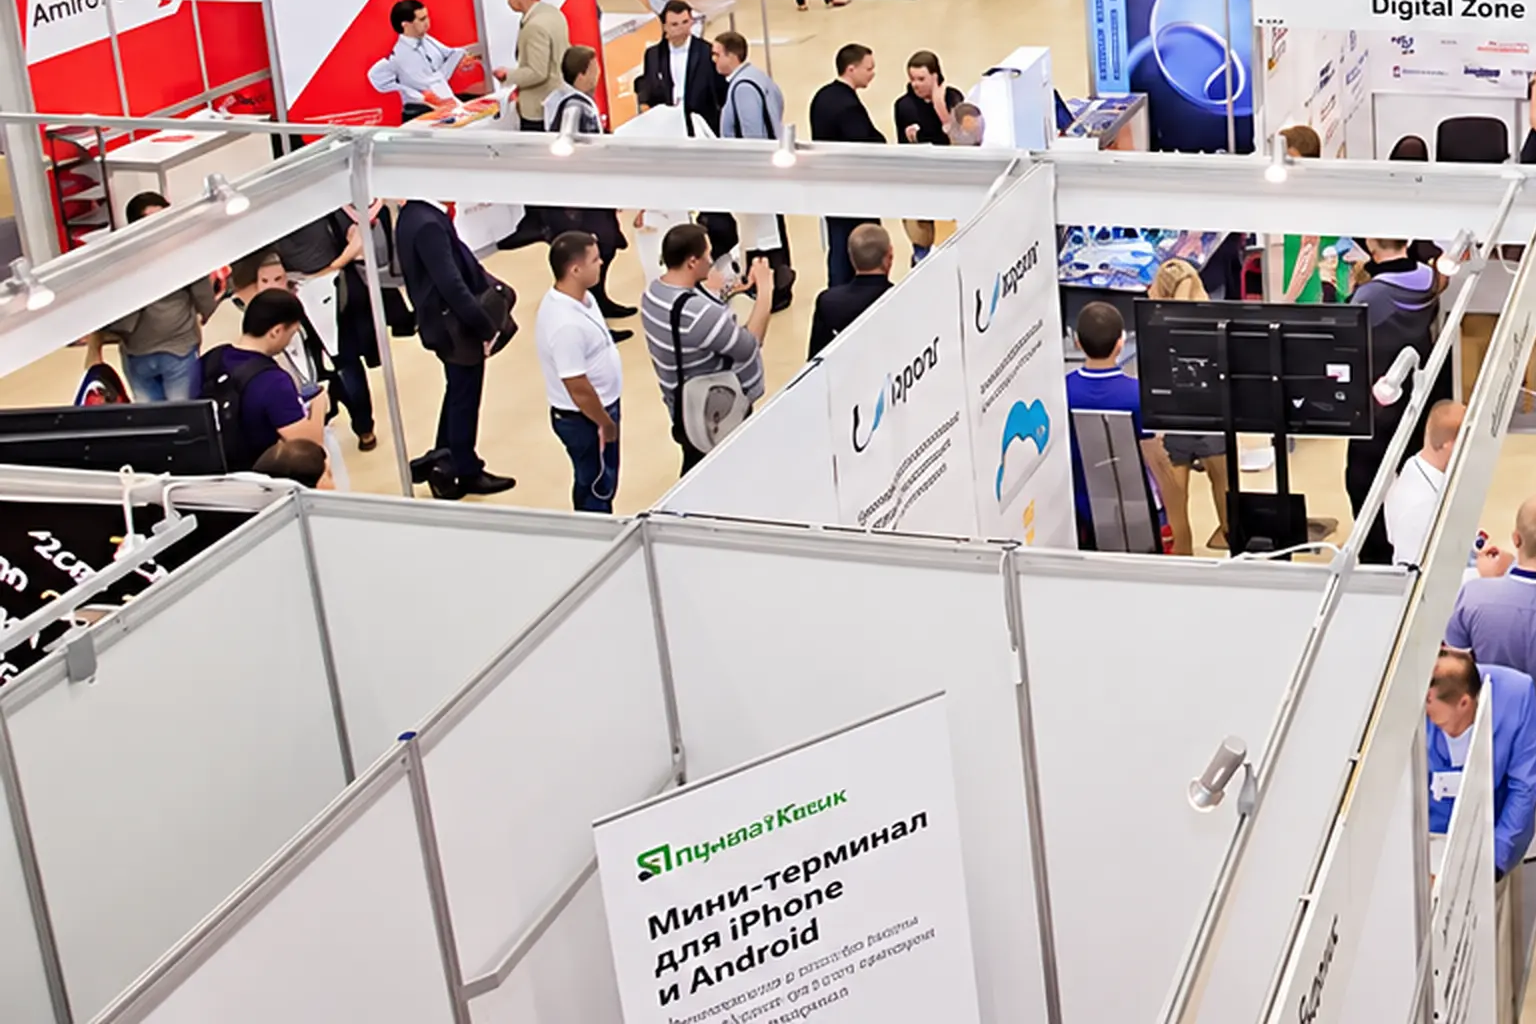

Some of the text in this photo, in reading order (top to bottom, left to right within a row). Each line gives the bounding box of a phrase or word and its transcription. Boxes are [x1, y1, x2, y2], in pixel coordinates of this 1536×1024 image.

[647, 811, 928, 940] Мини-терминал
[655, 878, 844, 978] для iPhone
[658, 983, 680, 1006] и
[689, 918, 820, 994] Android
